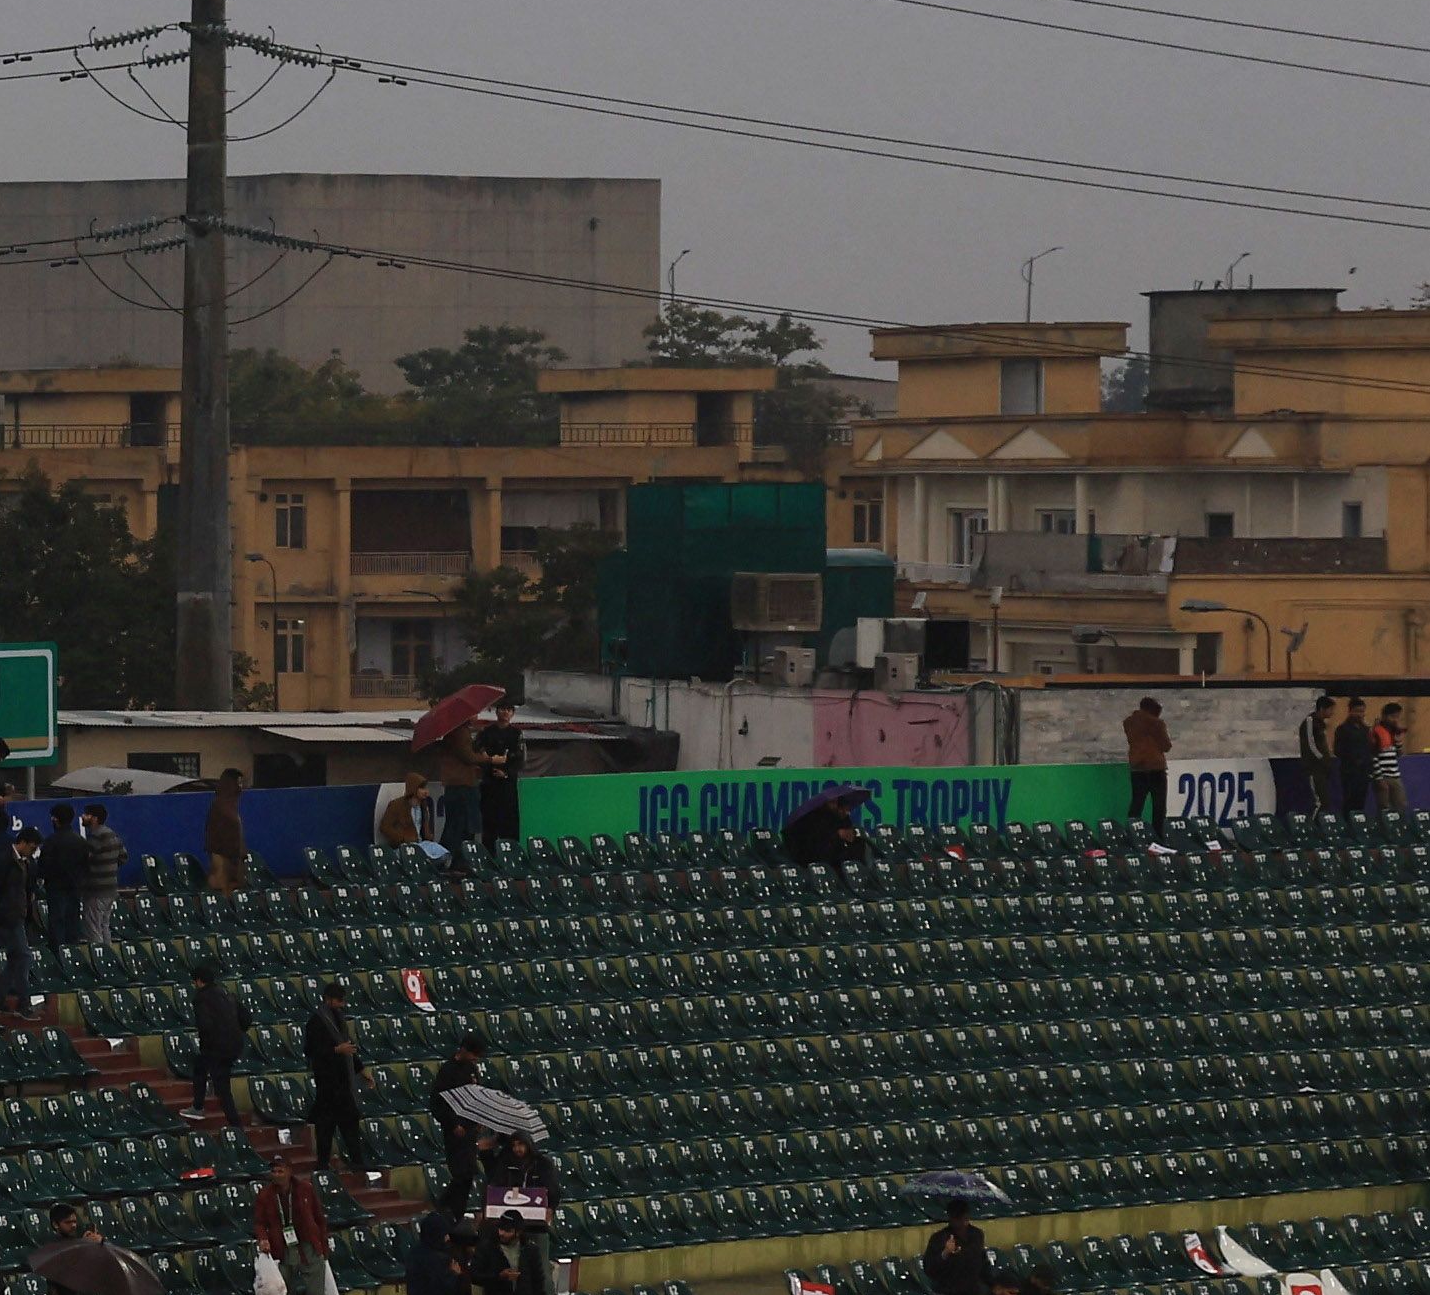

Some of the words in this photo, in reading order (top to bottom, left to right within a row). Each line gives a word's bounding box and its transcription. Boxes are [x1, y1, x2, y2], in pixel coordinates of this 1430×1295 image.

[639, 784, 689, 839] ICC
[892, 778, 1011, 836] TROPHY
[1179, 772, 1254, 827] 2025
